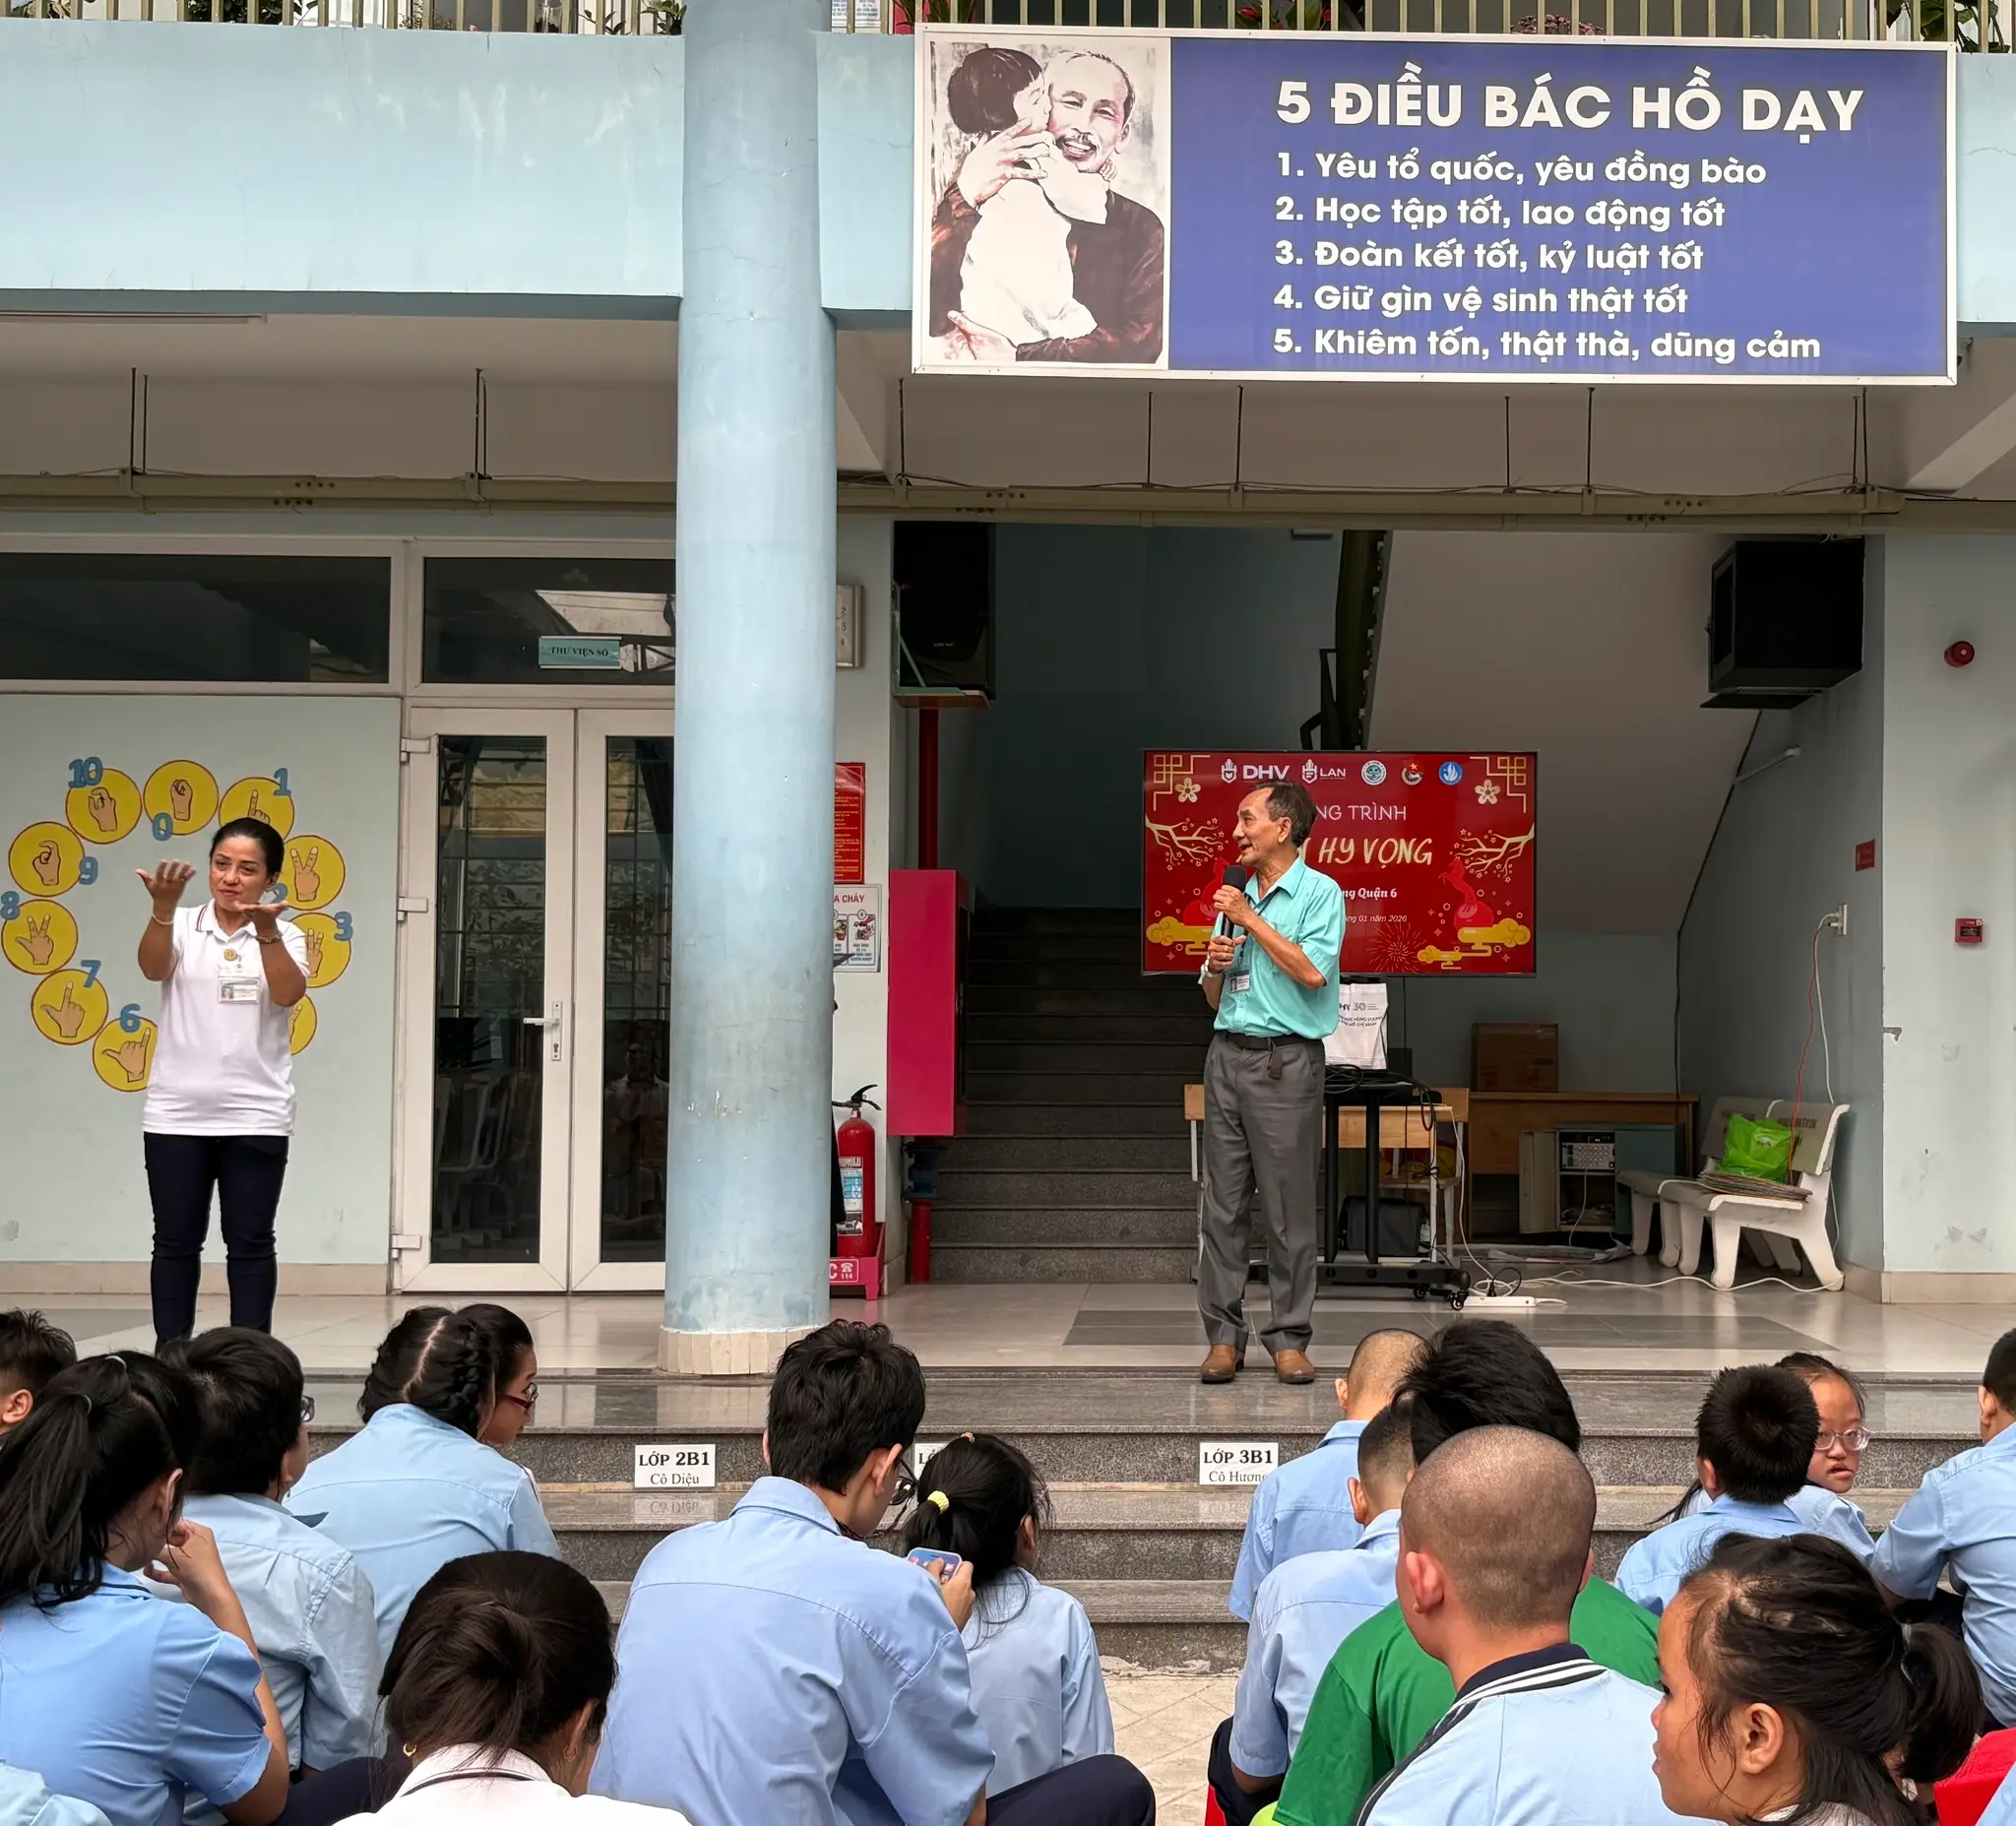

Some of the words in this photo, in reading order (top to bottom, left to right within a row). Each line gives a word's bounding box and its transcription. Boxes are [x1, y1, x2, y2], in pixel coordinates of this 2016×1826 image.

[1276, 80, 1311, 124] 5
[1330, 61, 1462, 128] ĐIỀU
[1484, 72, 1611, 129] BÁC
[1632, 65, 1722, 131] HỒ
[1742, 89, 1864, 145] DẠY
[1278, 152, 1304, 177] 1.
[1315, 152, 1377, 179] Yêu
[1386, 147, 1420, 180] tổ
[1429, 150, 1524, 186] quốc,
[1535, 155, 1594, 187] yêu
[1605, 149, 1690, 190] đồng
[1701, 156, 1767, 184] bào
[1275, 195, 1304, 221] 2.
[1315, 197, 1382, 229] Học
[1390, 197, 1448, 231] tập
[1457, 193, 1511, 229] tốt,
[1522, 200, 1575, 225] lao
[1585, 198, 1670, 233] động
[1679, 196, 1726, 227] tốt
[1275, 239, 1303, 266] 3.
[1314, 239, 1404, 268] Đoàn
[1415, 236, 1466, 268] kết
[1474, 237, 1528, 274] tốt,
[1539, 239, 1577, 275] kỷ
[1586, 242, 1651, 277] luật
[1658, 239, 1704, 271] tốt
[1273, 283, 1303, 309] 4.
[1313, 284, 1374, 311] Giữ
[1380, 283, 1432, 319] gìn
[1442, 284, 1482, 319] vệ
[1491, 287, 1558, 313] sinh
[1567, 285, 1635, 320] thật
[1642, 283, 1689, 314] tốt
[1273, 328, 1302, 353] 5.
[1314, 328, 1418, 355] Khiêm
[1426, 325, 1490, 361] tốn,
[1499, 329, 1568, 364] thật
[1575, 329, 1640, 362] thà,
[1650, 331, 1736, 365] dũng
[1745, 329, 1821, 358] cảm
[551, 646, 571, 655] THƯ
[572, 645, 595, 658] VIỆN
[68, 756, 103, 788] 10
[273, 768, 291, 795] 1
[1242, 765, 1290, 780] DHV
[1319, 768, 1346, 777] LAN
[1347, 800, 1407, 821] TRÌNH
[152, 812, 173, 841] 0
[1362, 837, 1432, 869] VỌNG
[79, 856, 98, 885] 9
[0, 891, 21, 920] 8
[842, 893, 865, 903] CHÁY
[1357, 886, 1388, 901] Quận
[1390, 888, 1398, 898] 6
[334, 912, 353, 941] 3
[80, 960, 101, 988] 7
[120, 1003, 141, 1033] 6
[639, 1451, 670, 1466] LỚP
[675, 1451, 710, 1466] 2B1
[1204, 1448, 1234, 1464] LỚP
[1239, 1449, 1273, 1464] 3B1
[650, 1474, 667, 1484] Cô
[671, 1473, 700, 1486] Diệu
[1209, 1471, 1226, 1482] Cô
